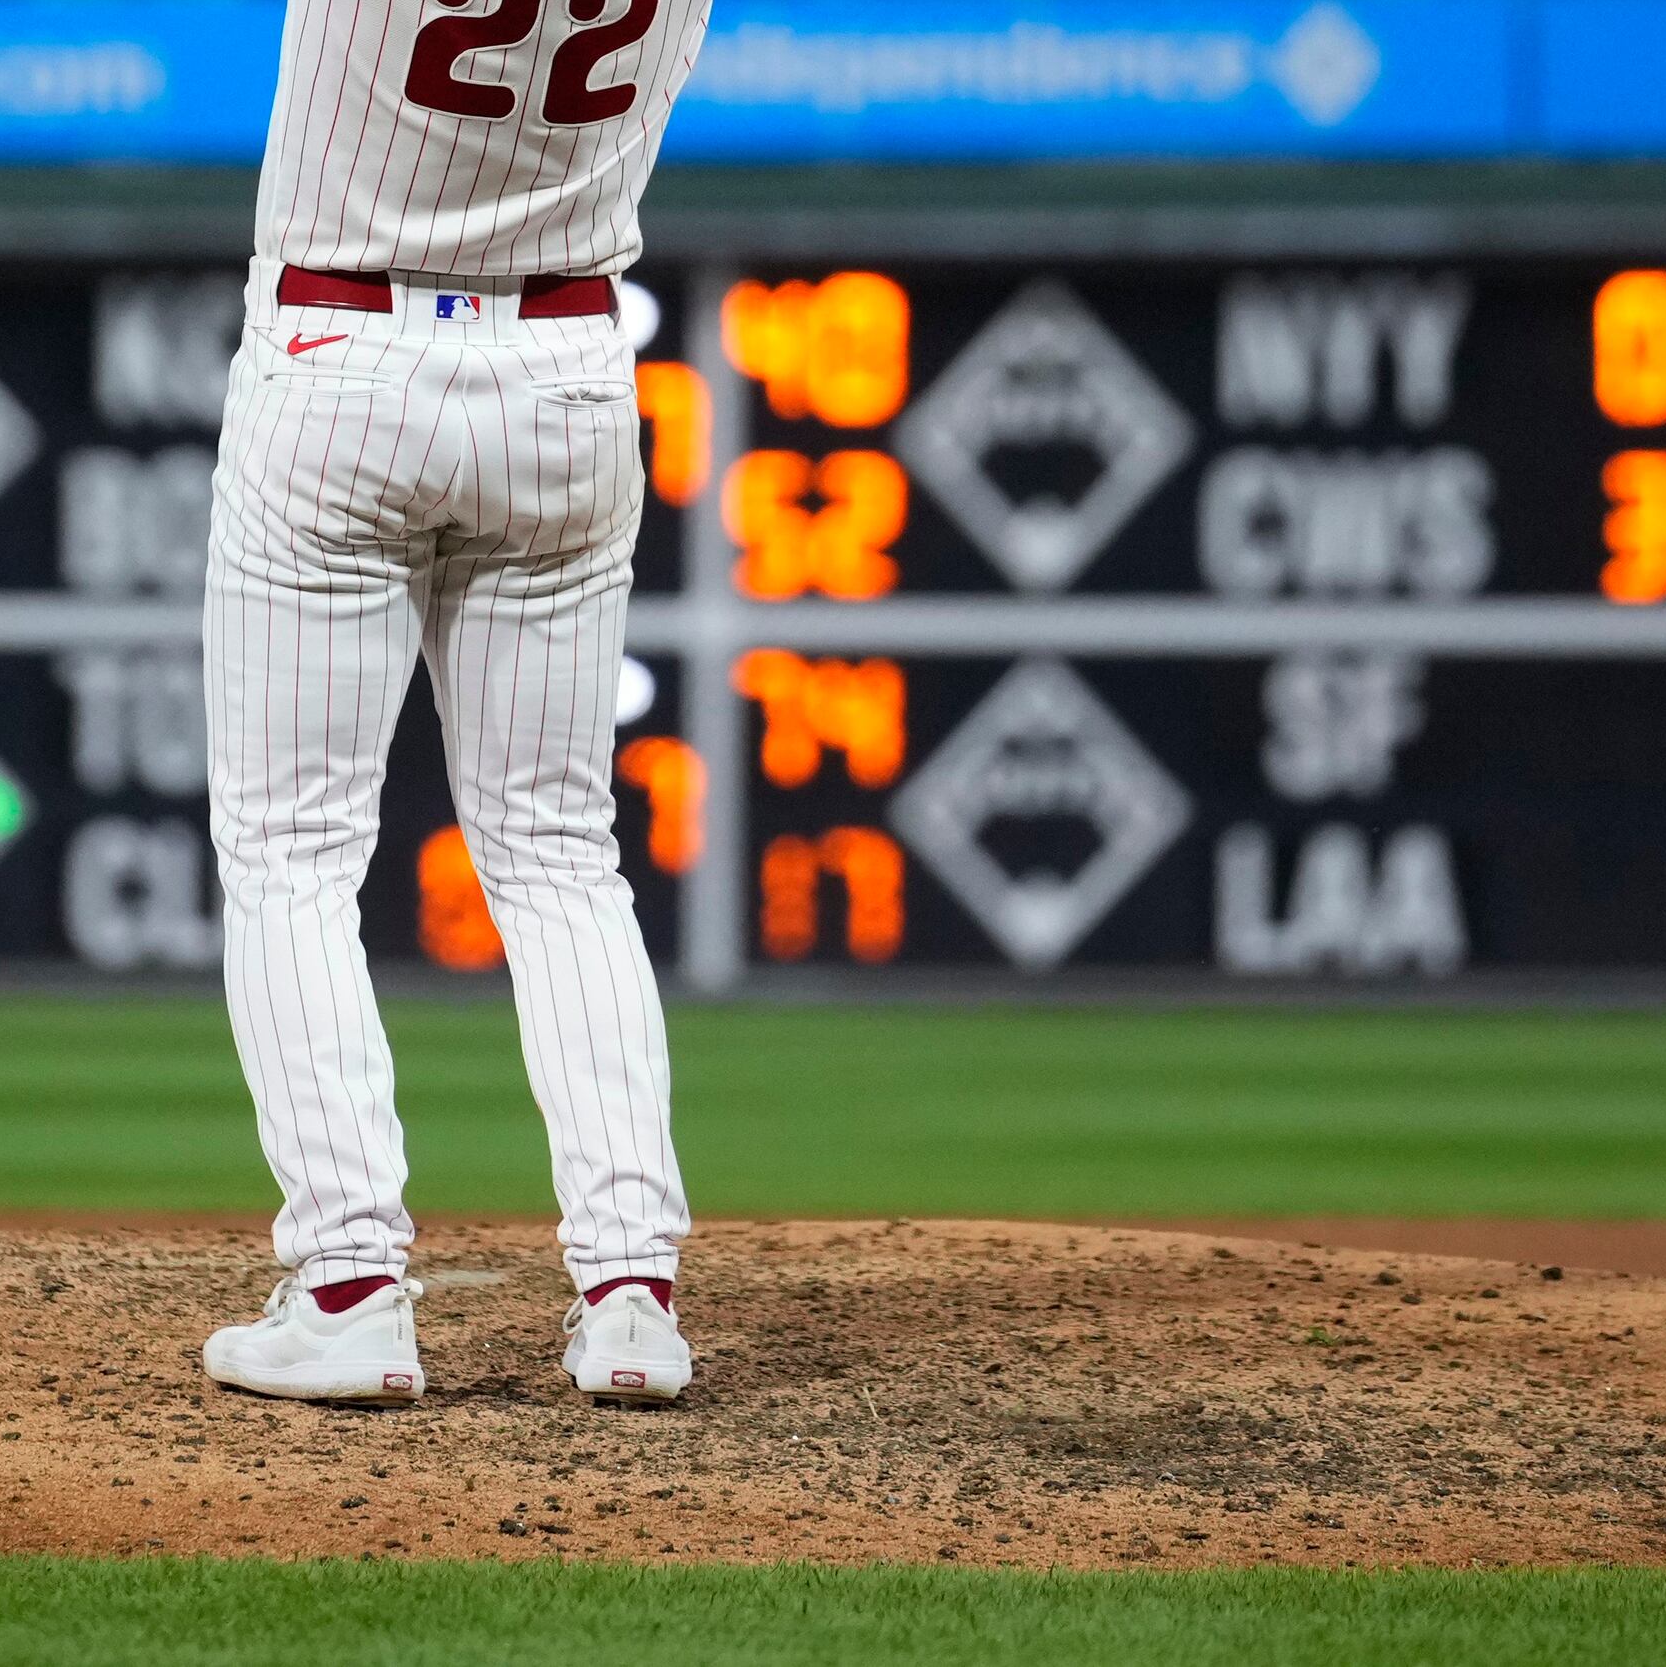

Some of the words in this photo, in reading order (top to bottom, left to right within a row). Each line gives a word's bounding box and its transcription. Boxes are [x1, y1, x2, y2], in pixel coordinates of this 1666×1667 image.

[721, 270, 911, 429] 40
[1219, 272, 1467, 428] NYY
[721, 447, 909, 600] 52
[1198, 446, 1493, 600] CWS
[731, 649, 907, 789] 74
[1263, 650, 1425, 800] SF
[759, 826, 906, 966] 17
[1215, 822, 1469, 974] LAA
